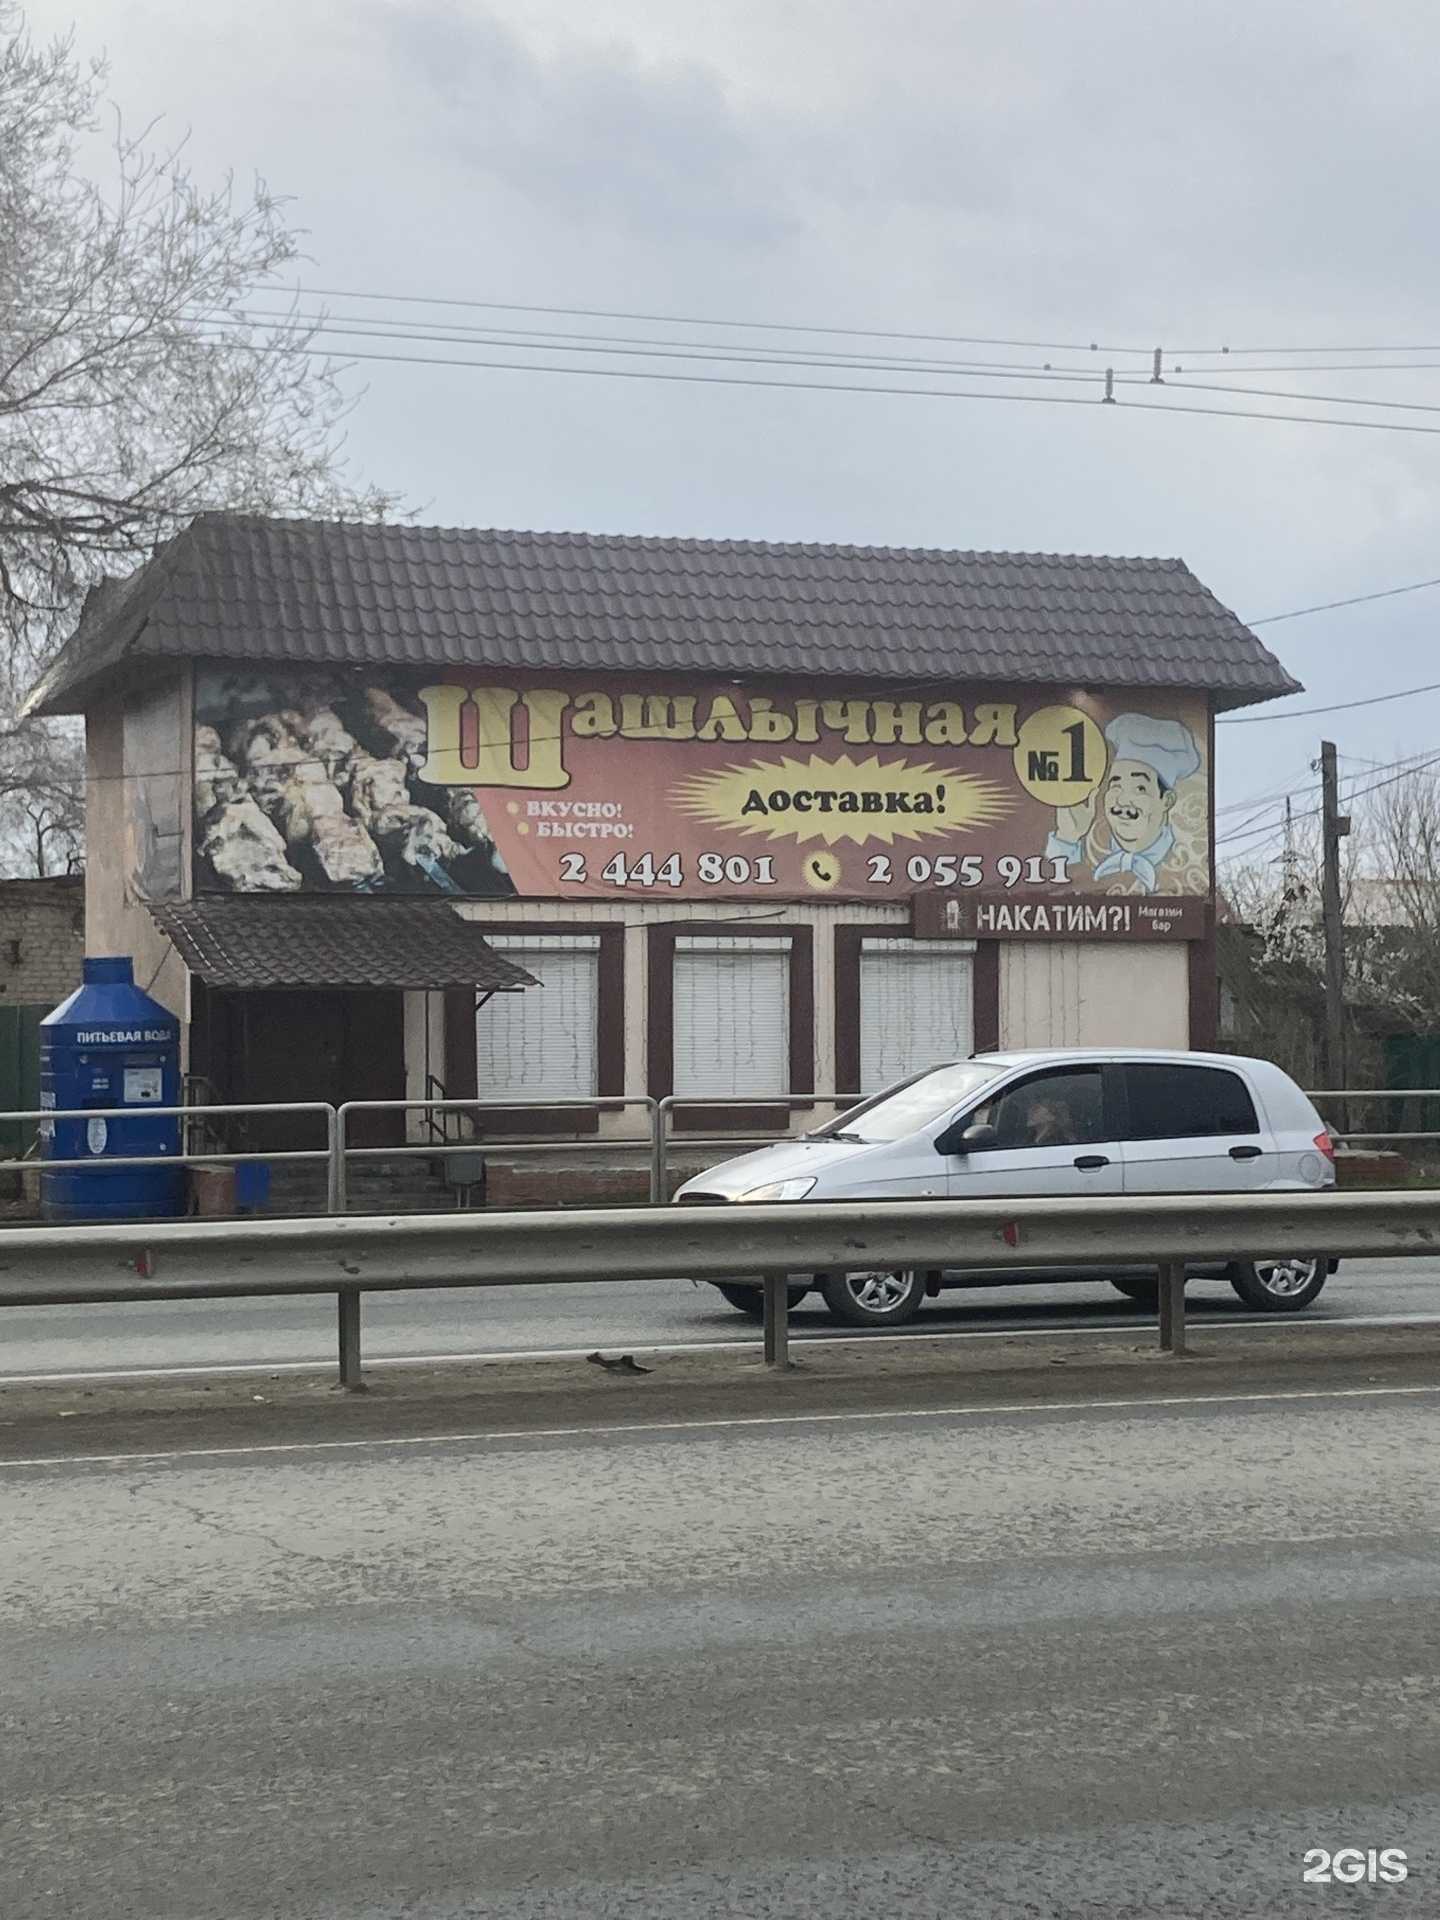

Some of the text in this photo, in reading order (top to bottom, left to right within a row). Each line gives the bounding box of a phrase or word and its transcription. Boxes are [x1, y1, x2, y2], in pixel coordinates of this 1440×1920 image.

[417, 684, 1019, 789] Шашлычная
[526, 800, 622, 819] ВКУСНО!
[536, 821, 634, 840] БЫСТРО!
[560, 852, 777, 888] 2 444 801
[866, 855, 1072, 888] 2 055 911
[977, 905, 1130, 932] НАКАТИМ?!
[1152, 919, 1171, 932] бар
[77, 1031, 142, 1043] ПИТЬЕВАЯ
